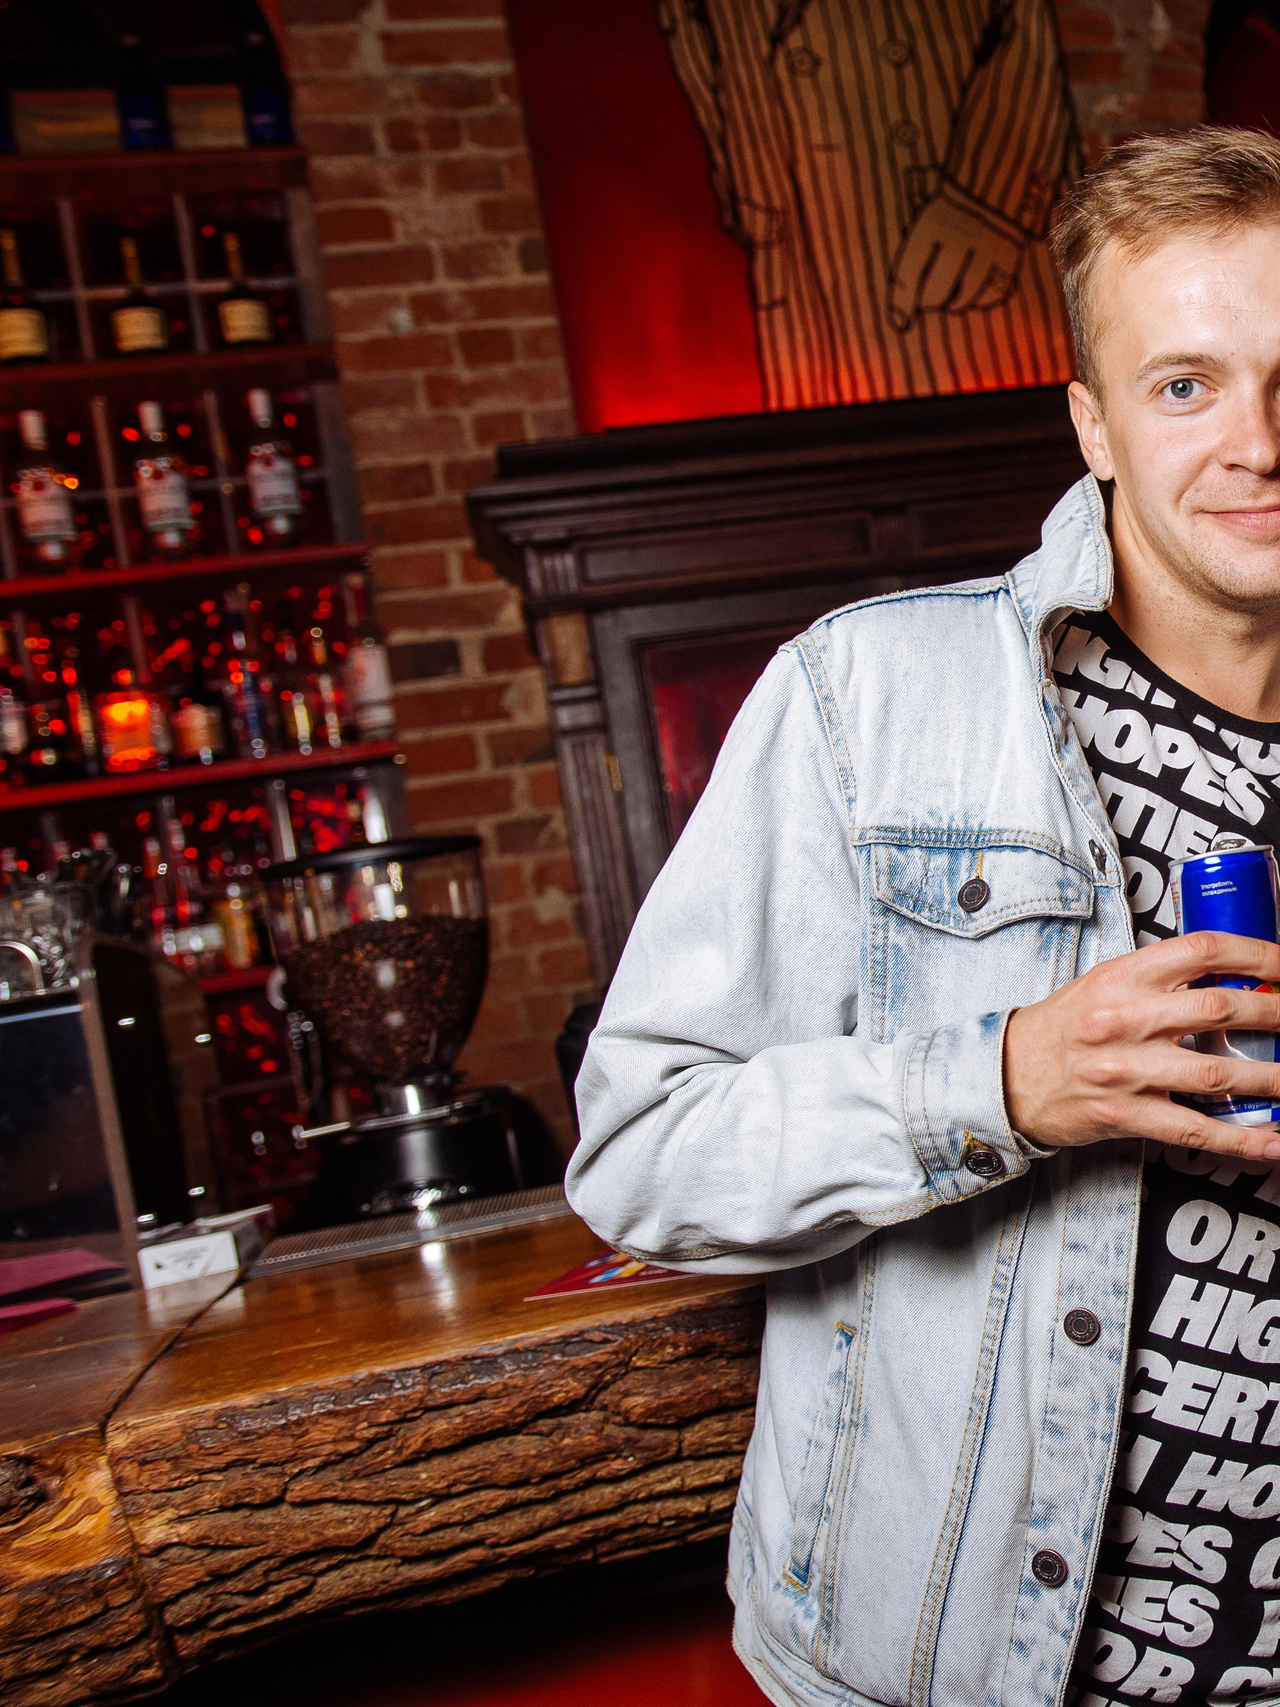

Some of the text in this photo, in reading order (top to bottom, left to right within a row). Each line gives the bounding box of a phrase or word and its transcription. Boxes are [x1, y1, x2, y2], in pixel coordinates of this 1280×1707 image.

[1060, 686, 1272, 826] HOPES
[1200, 881, 1233, 890] Употреблять
[1080, 1627, 1196, 1704] OR
